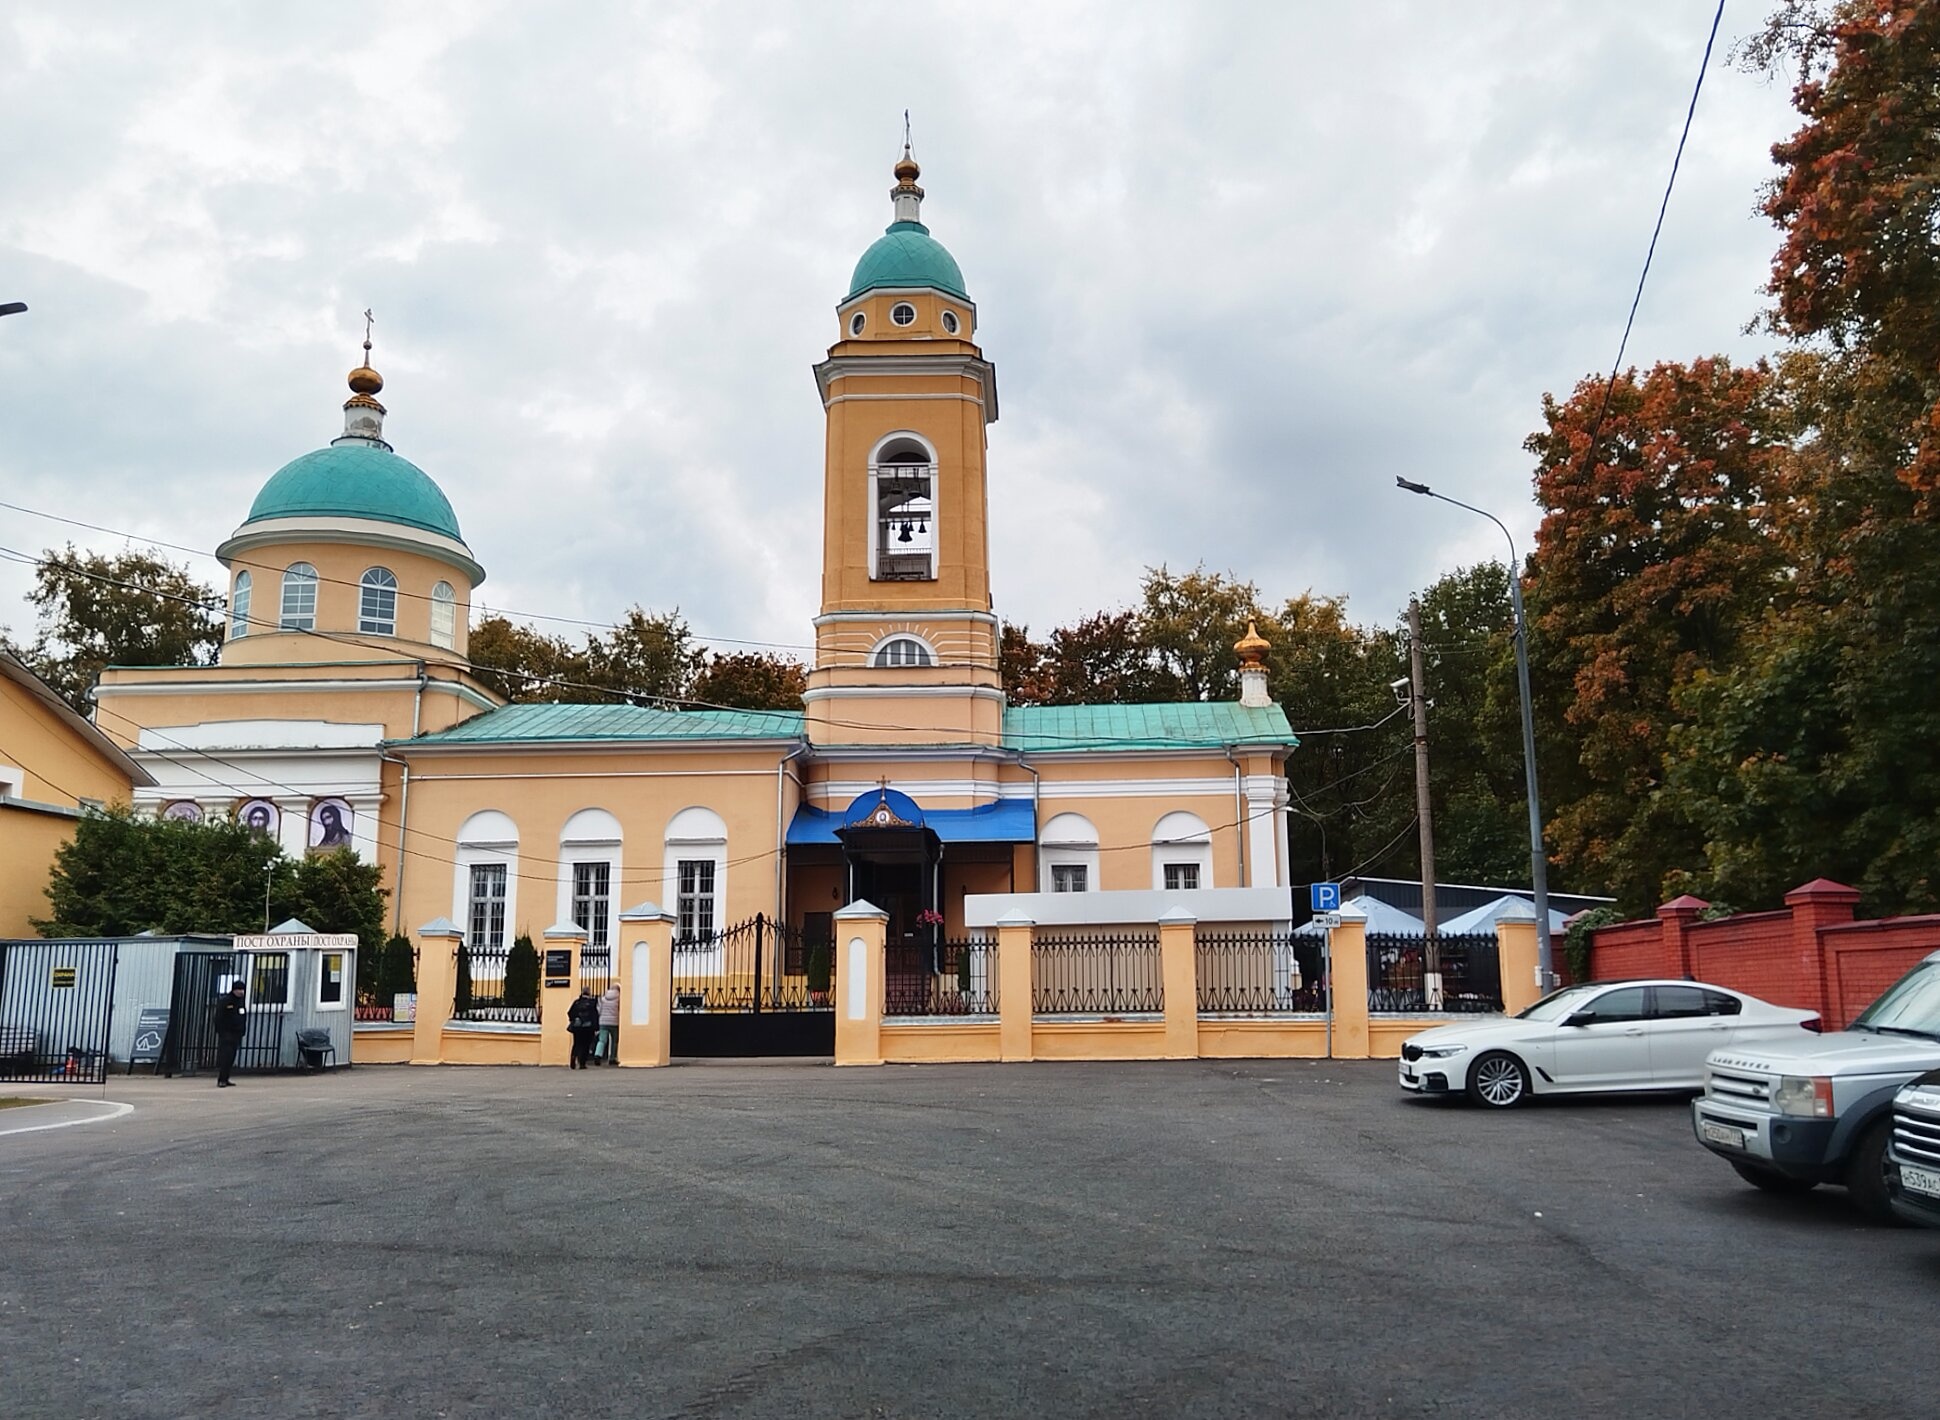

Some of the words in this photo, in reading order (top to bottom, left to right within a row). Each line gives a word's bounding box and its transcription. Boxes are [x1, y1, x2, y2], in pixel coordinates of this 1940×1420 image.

[1319, 886, 1335, 908] P
[236, 936, 265, 948] ПОСТ
[266, 935, 310, 947] ОХРАНЫ
[314, 936, 331, 947] ПОСТ
[332, 936, 356, 947] ОХРАНЫ
